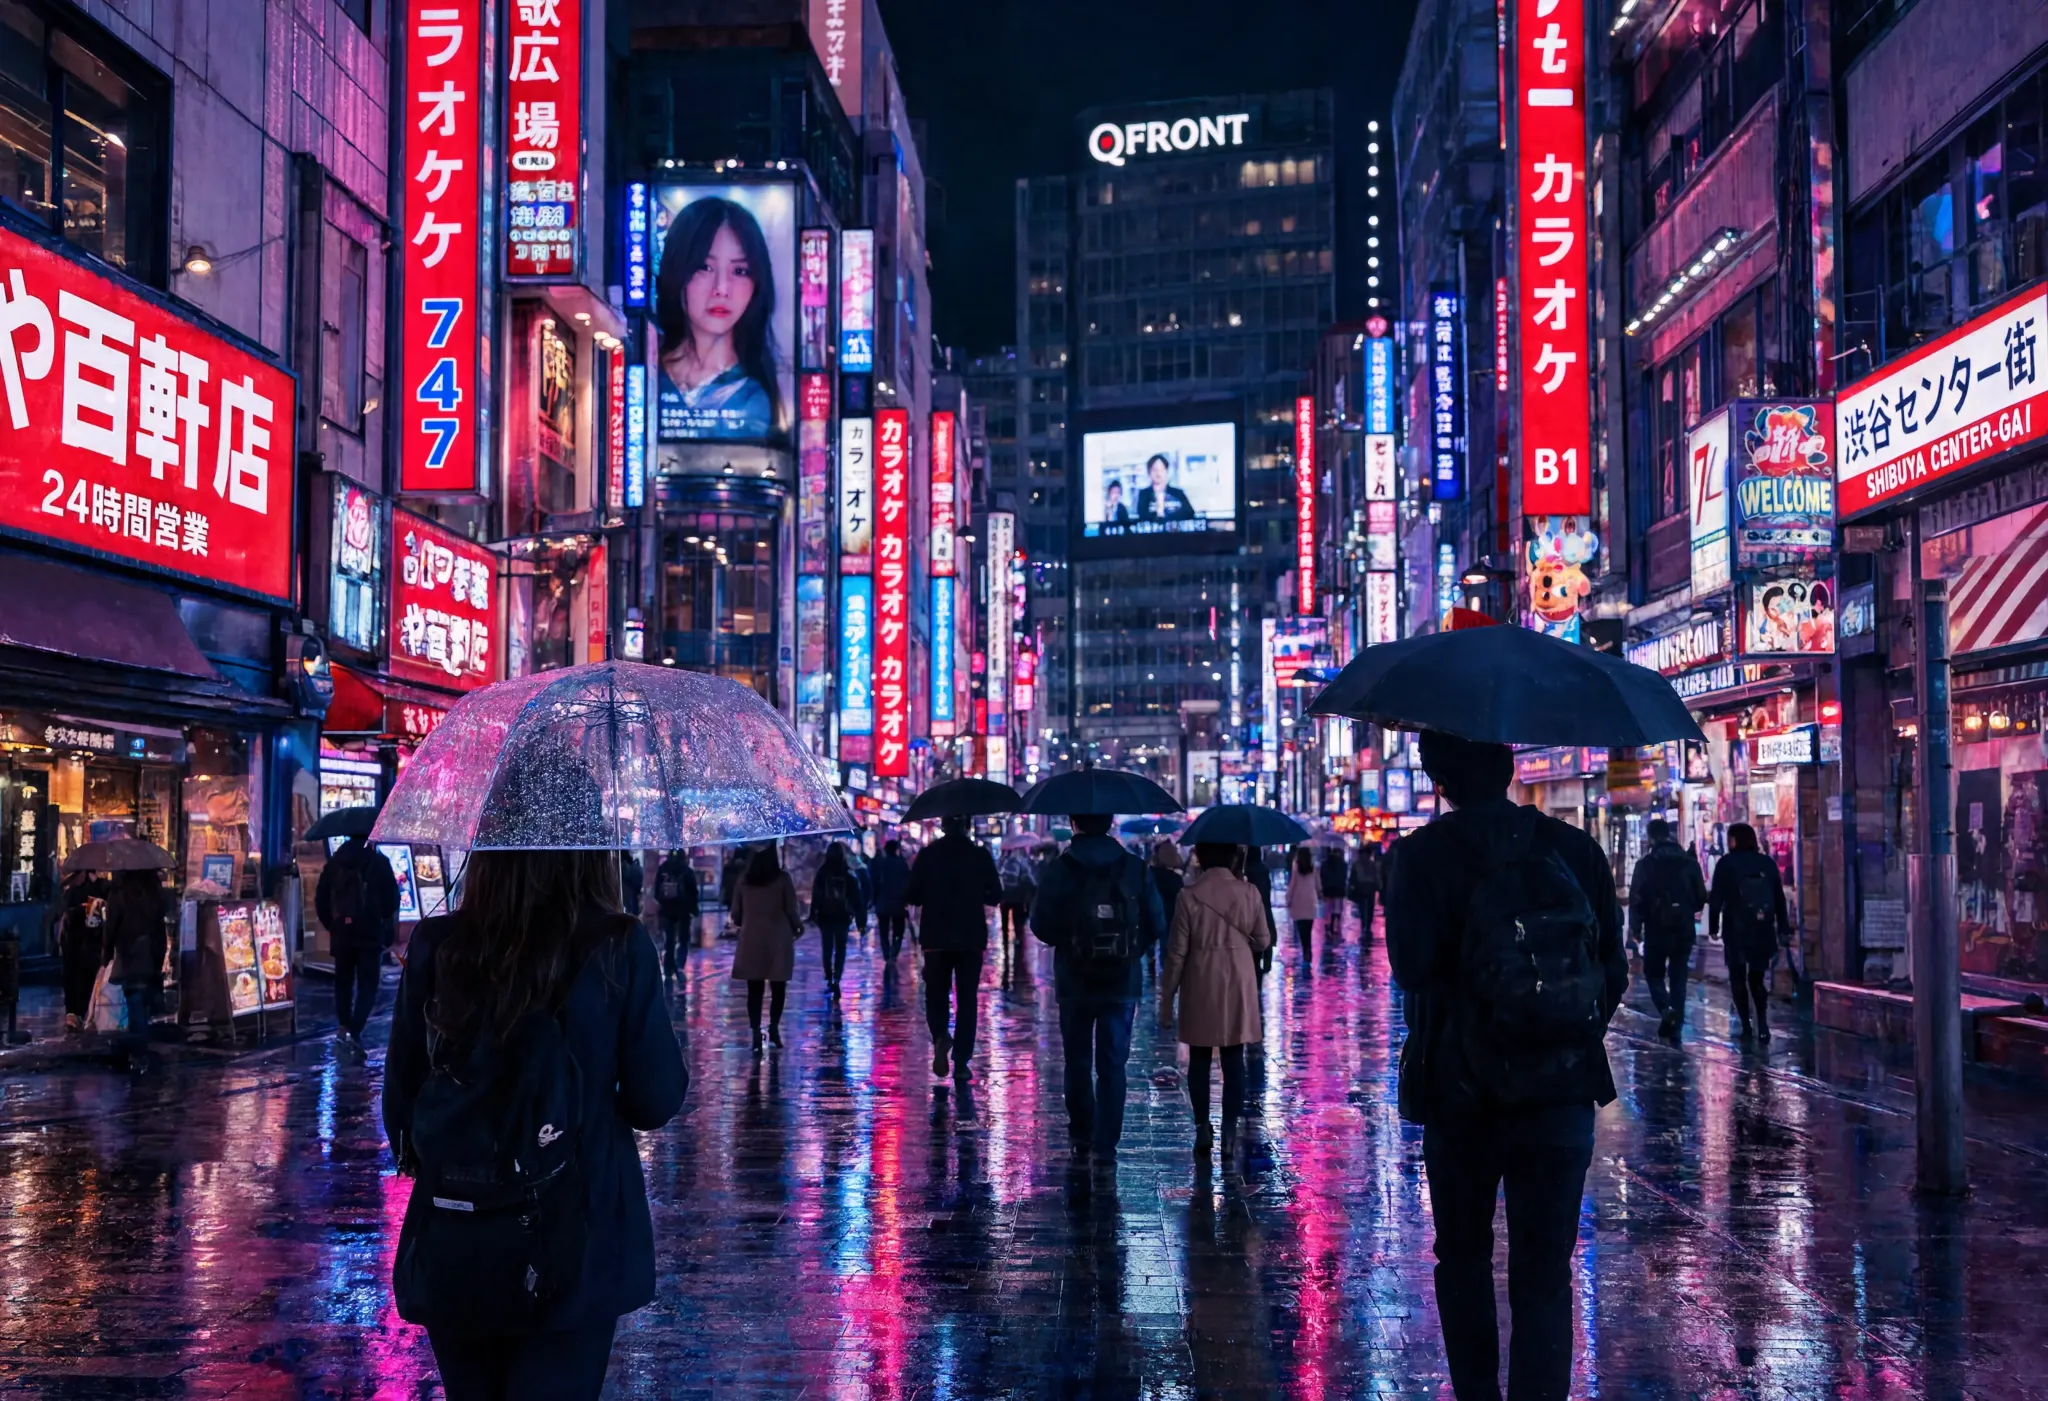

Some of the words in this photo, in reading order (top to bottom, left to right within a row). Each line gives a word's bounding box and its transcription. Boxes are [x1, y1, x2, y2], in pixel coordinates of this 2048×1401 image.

[1089, 113, 1249, 166] QFRONT
[1532, 153, 1577, 394] カラオケ
[416, 297, 463, 469] 747
[1844, 317, 2036, 465] 渋谷センター街
[41, 469, 209, 558] 24時間営業
[881, 418, 904, 523] カラオケ
[1534, 448, 1578, 486] B1
[1742, 477, 1832, 516] WELCOME
[1866, 450, 1927, 499] SHIBUYA
[880, 533, 904, 645] カラオケ
[879, 655, 904, 766] カラオケ
